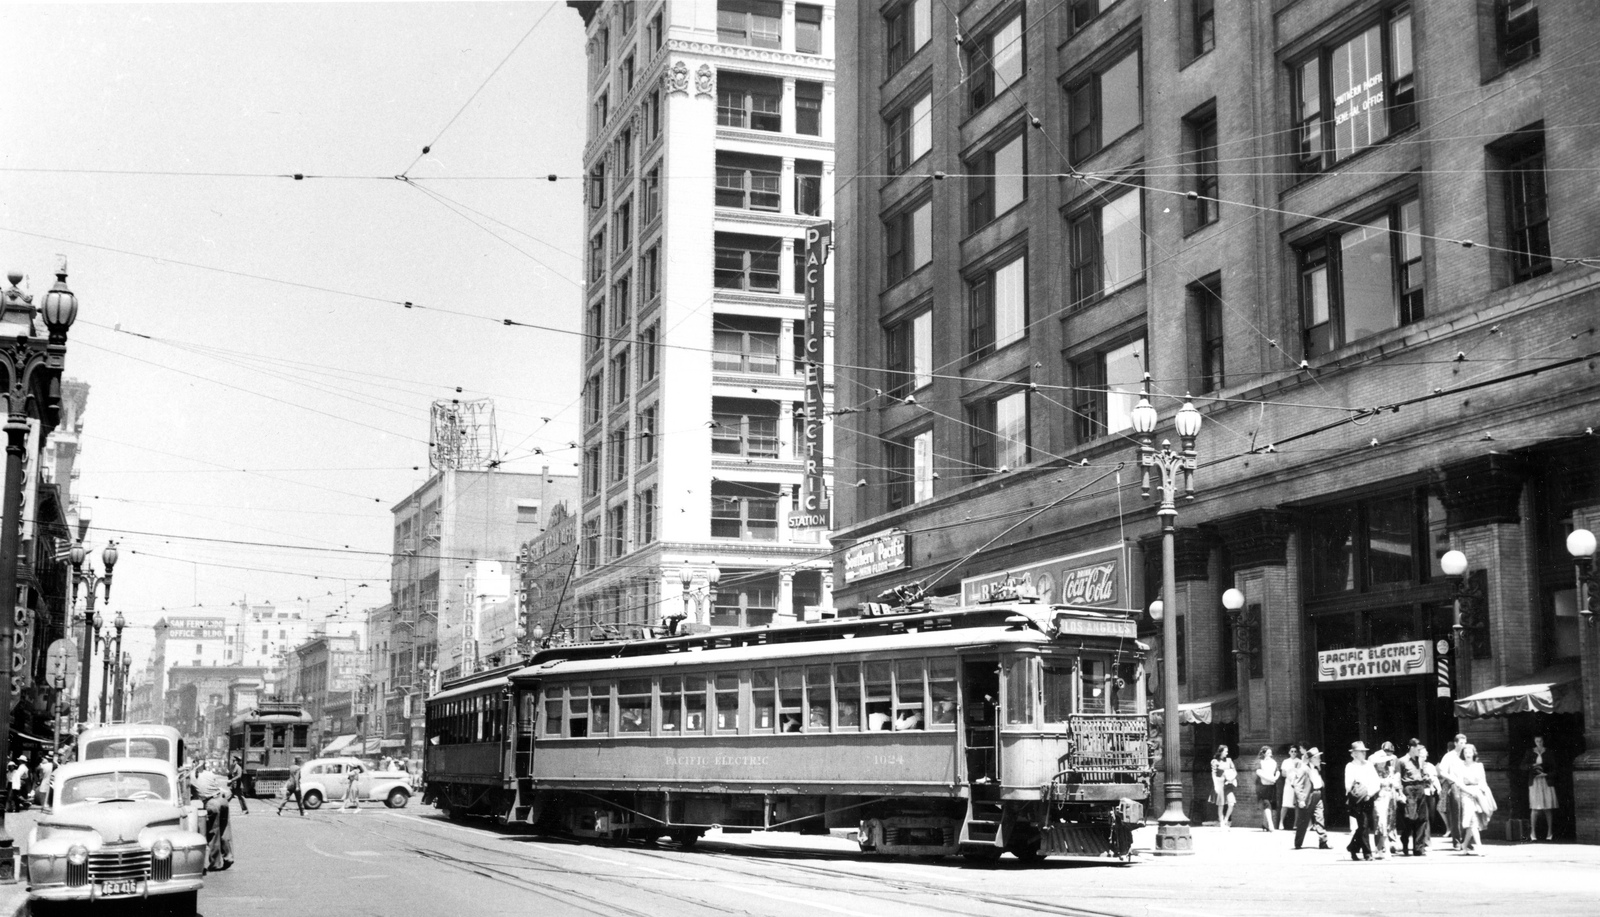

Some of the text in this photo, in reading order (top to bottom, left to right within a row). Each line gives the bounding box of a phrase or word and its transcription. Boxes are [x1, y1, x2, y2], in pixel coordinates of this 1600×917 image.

[805, 228, 820, 354] PACIFIC
[805, 363, 819, 511] ELECTRIC
[788, 514, 826, 527] STATION
[1063, 563, 1114, 605] Coca-Cola
[170, 619, 224, 628] SAN FERNANDO
[463, 576, 476, 677] BURBAN
[1065, 621, 1131, 634] LOS ANGELES
[169, 629, 196, 637] OFFICE
[1326, 644, 1416, 664] PACIFIC ELECTRIC
[1340, 660, 1402, 677] STATION
[665, 754, 905, 766] PACIFIC ELECTRIC 1024
